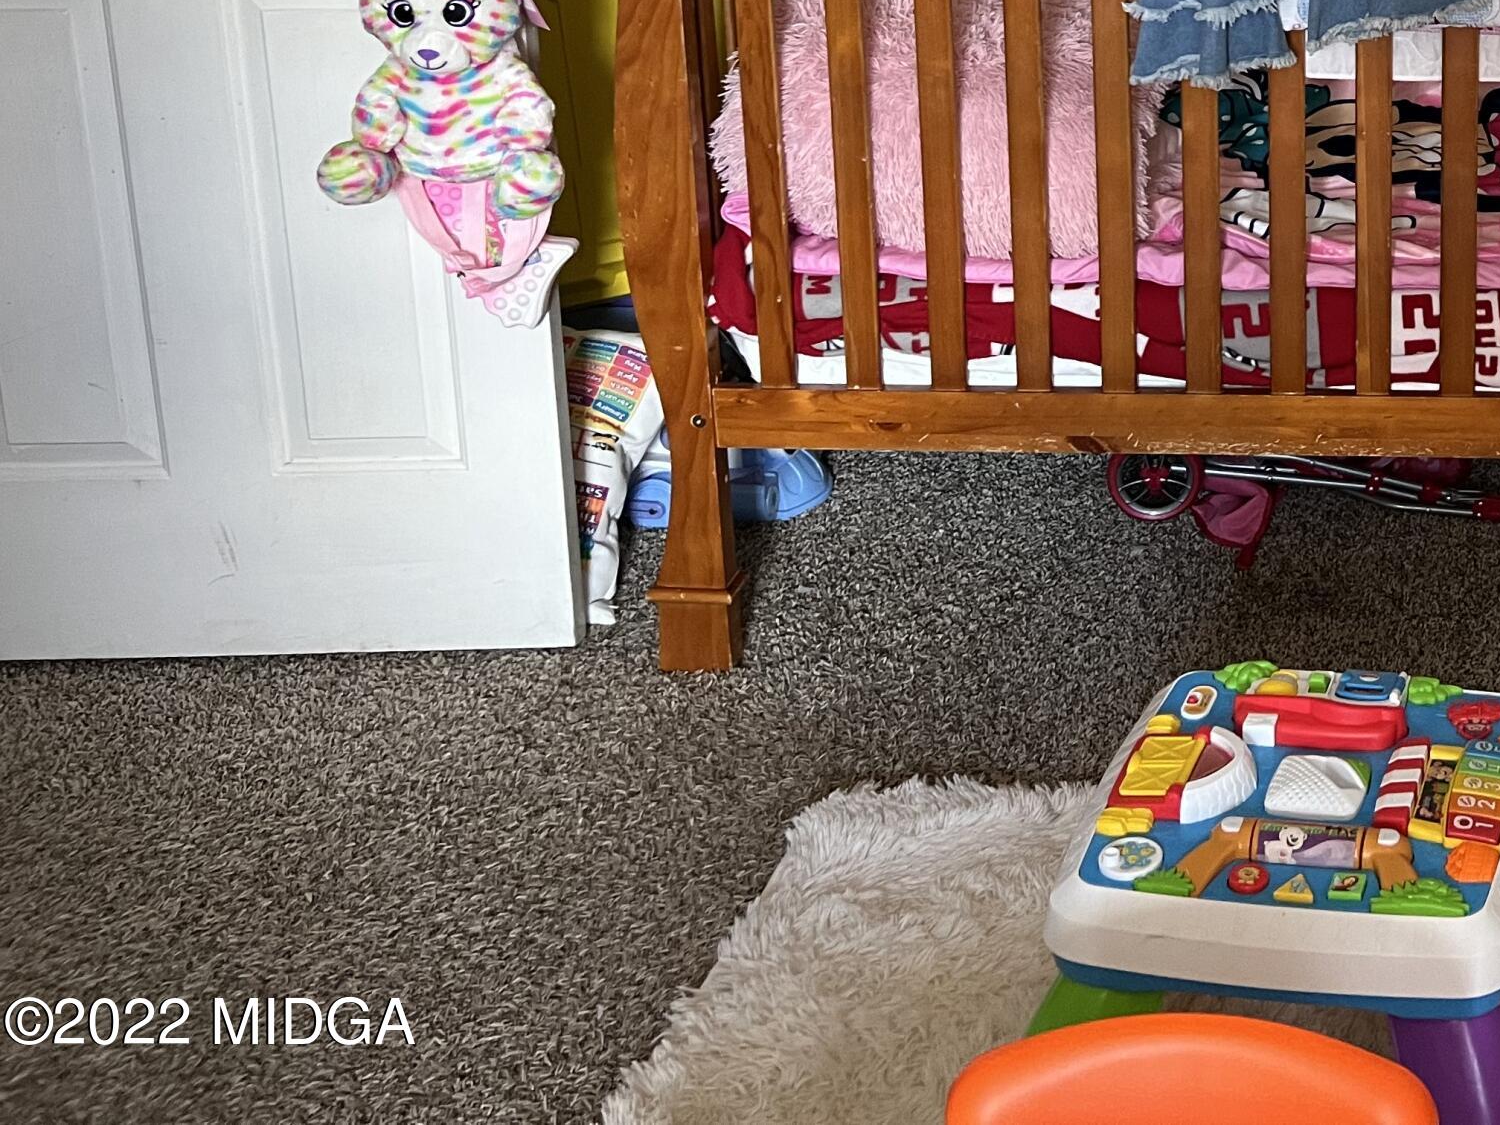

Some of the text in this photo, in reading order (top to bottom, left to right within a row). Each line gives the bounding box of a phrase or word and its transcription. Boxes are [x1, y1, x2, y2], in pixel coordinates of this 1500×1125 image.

[624, 359, 642, 371] May
[617, 371, 638, 383] April
[610, 381, 635, 396] March
[595, 401, 625, 420] January
[1484, 781, 1500, 791] 3
[1477, 800, 1496, 810] 2
